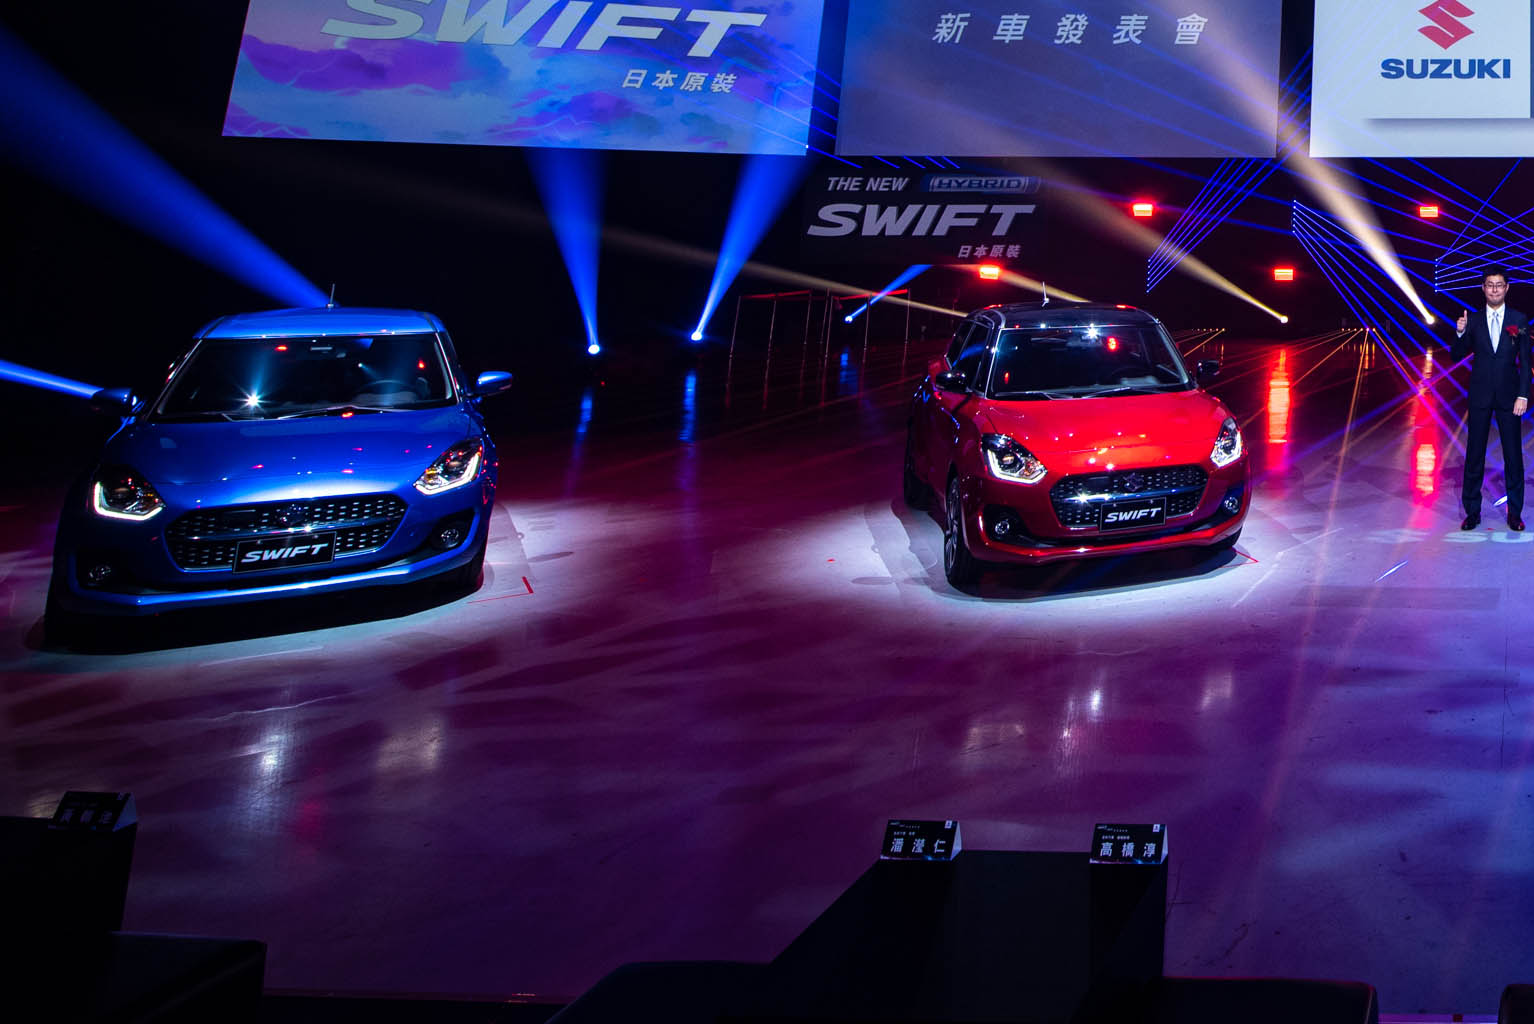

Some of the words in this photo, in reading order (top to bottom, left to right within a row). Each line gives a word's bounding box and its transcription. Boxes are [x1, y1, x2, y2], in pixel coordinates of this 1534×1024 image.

[932, 12, 1209, 45] 新車發表會
[1380, 58, 1511, 79] SUZUKI
[622, 69, 737, 94] 日本原裝
[827, 177, 863, 192] THE
[866, 177, 909, 192] NEW
[936, 178, 1022, 190] HYBRID
[807, 204, 1036, 237] SWIFT
[957, 244, 1022, 258] 日本原裝
[1105, 507, 1161, 523] SWIFT
[241, 543, 330, 563] SWIFT
